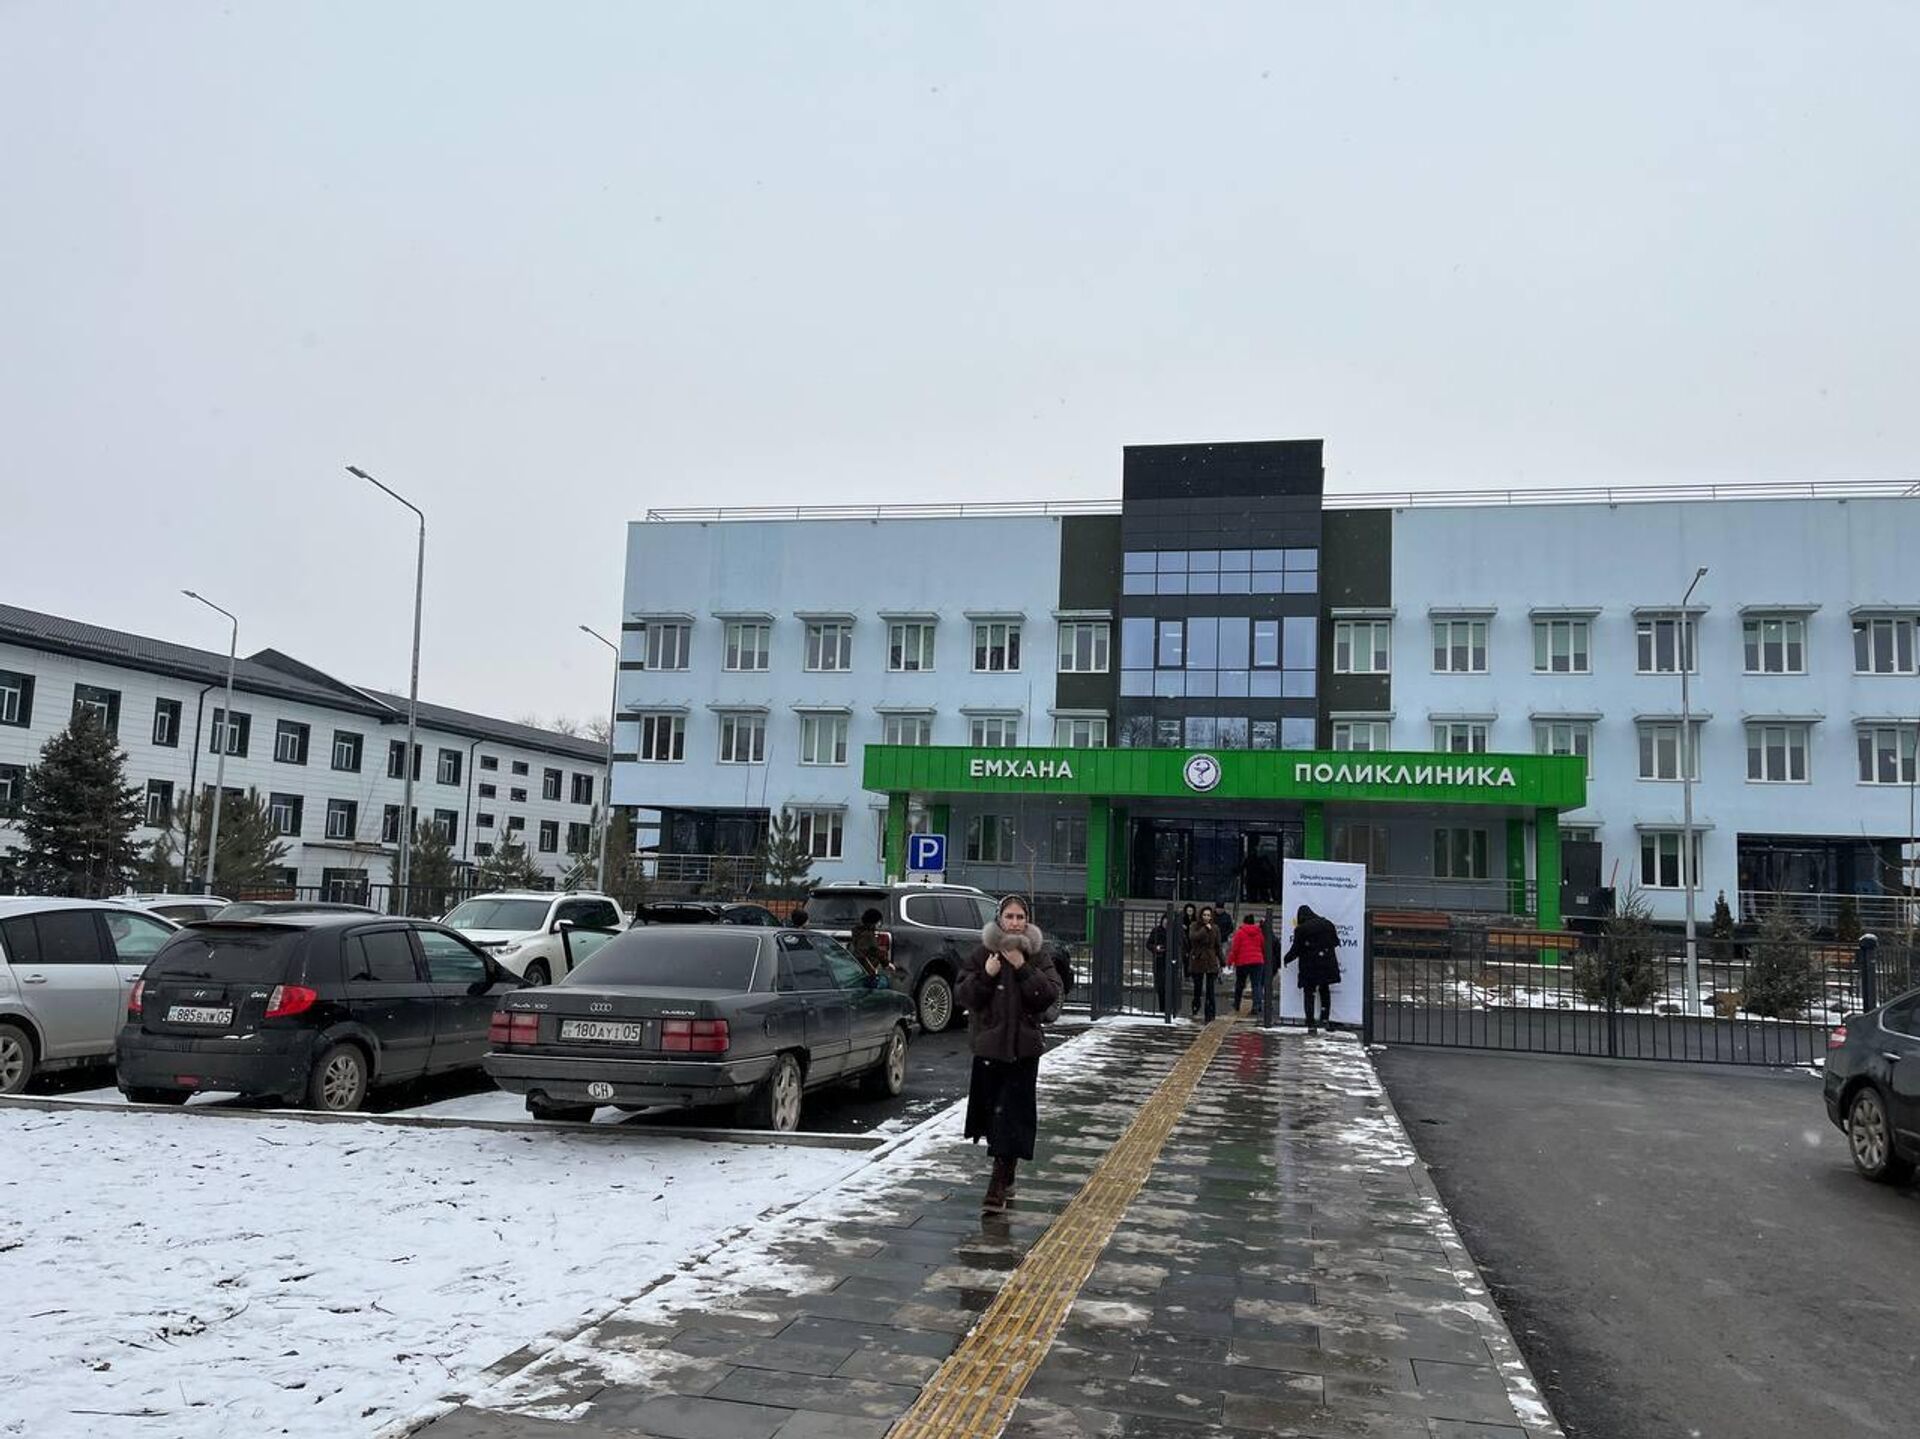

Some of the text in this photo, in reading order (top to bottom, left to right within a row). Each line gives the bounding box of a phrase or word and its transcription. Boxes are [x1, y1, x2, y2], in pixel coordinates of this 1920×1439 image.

[970, 759, 1073, 779] ЕМХАНА
[1295, 763, 1516, 786] ПОЛИКЛИНИКА
[919, 838, 939, 867] P
[593, 1083, 609, 1097] CH
